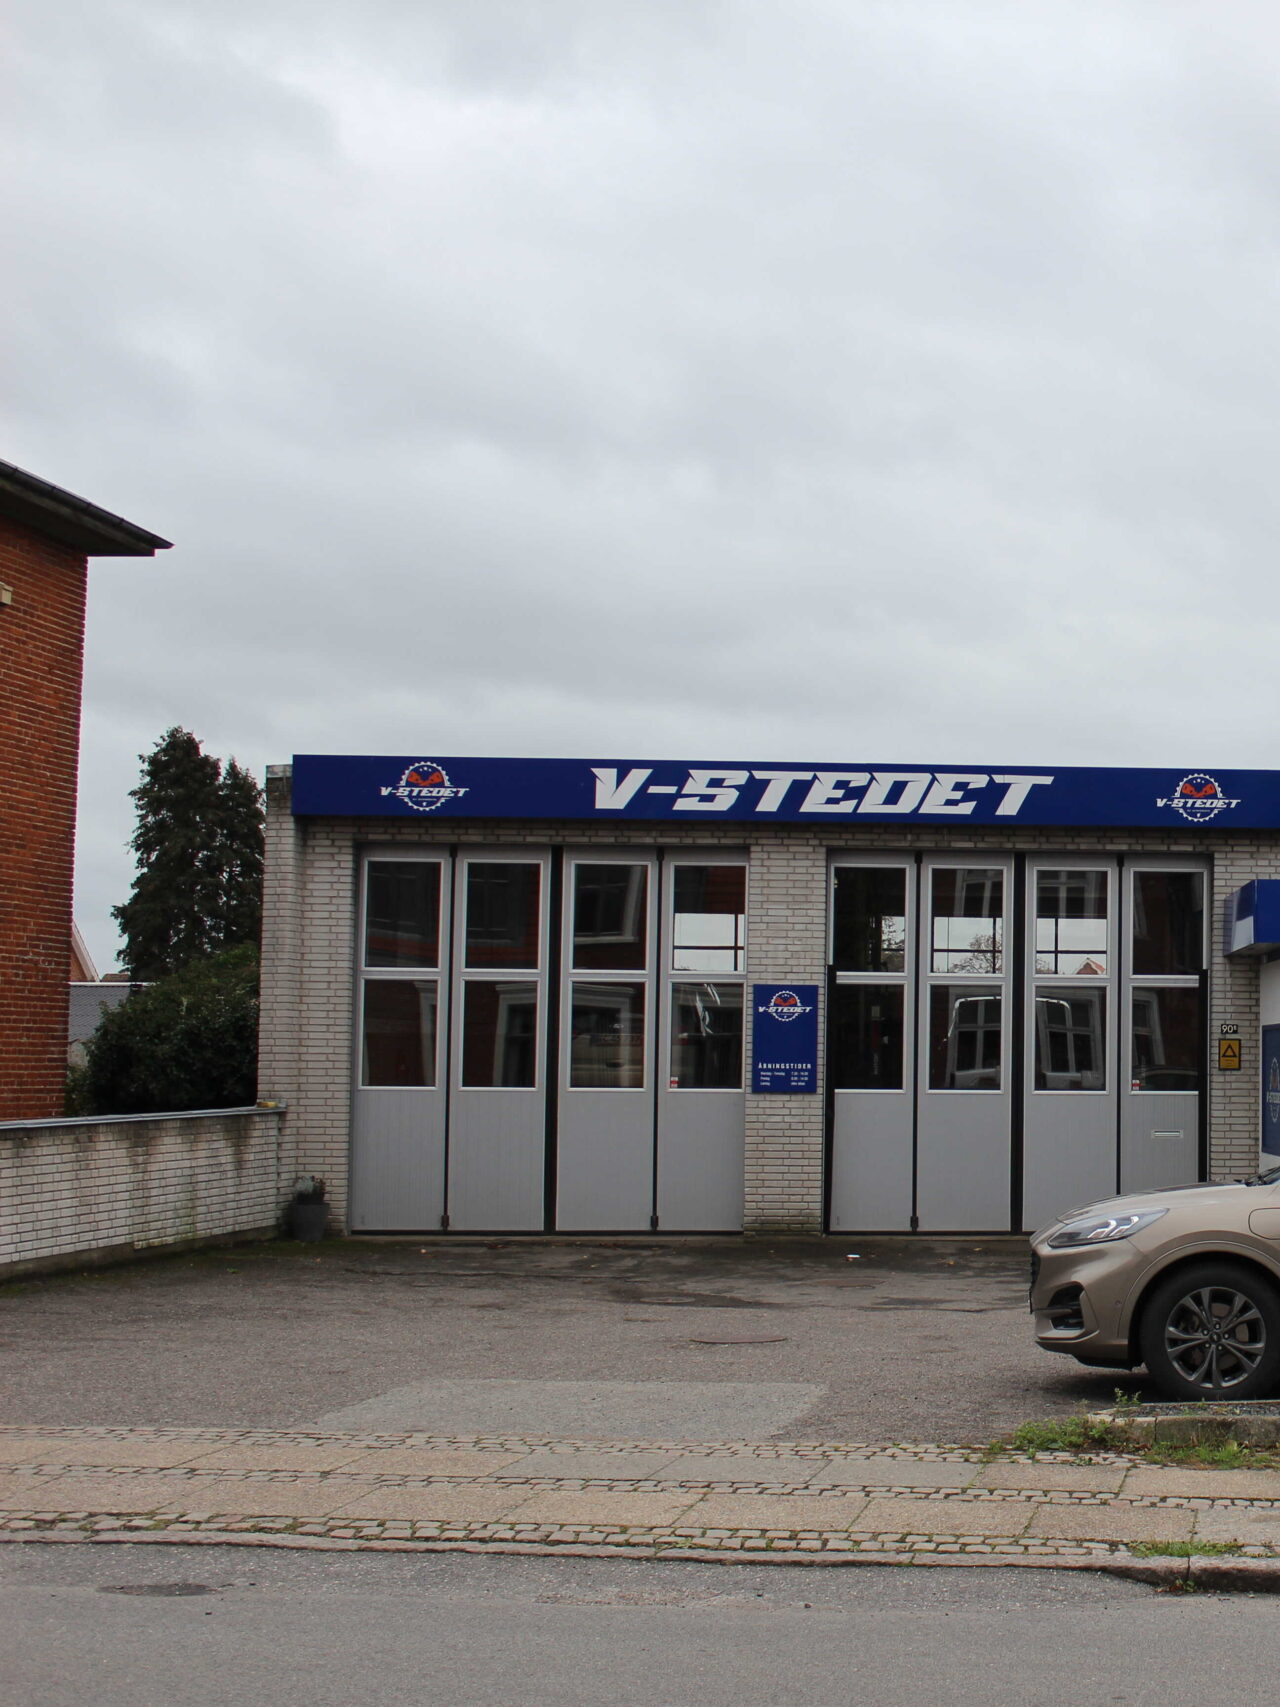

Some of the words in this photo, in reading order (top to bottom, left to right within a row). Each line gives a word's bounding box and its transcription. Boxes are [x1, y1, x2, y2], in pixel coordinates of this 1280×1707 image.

[380, 786, 470, 797] V-STEDET
[591, 767, 1054, 816] V-STEDET
[1156, 798, 1242, 809] V-STEDET
